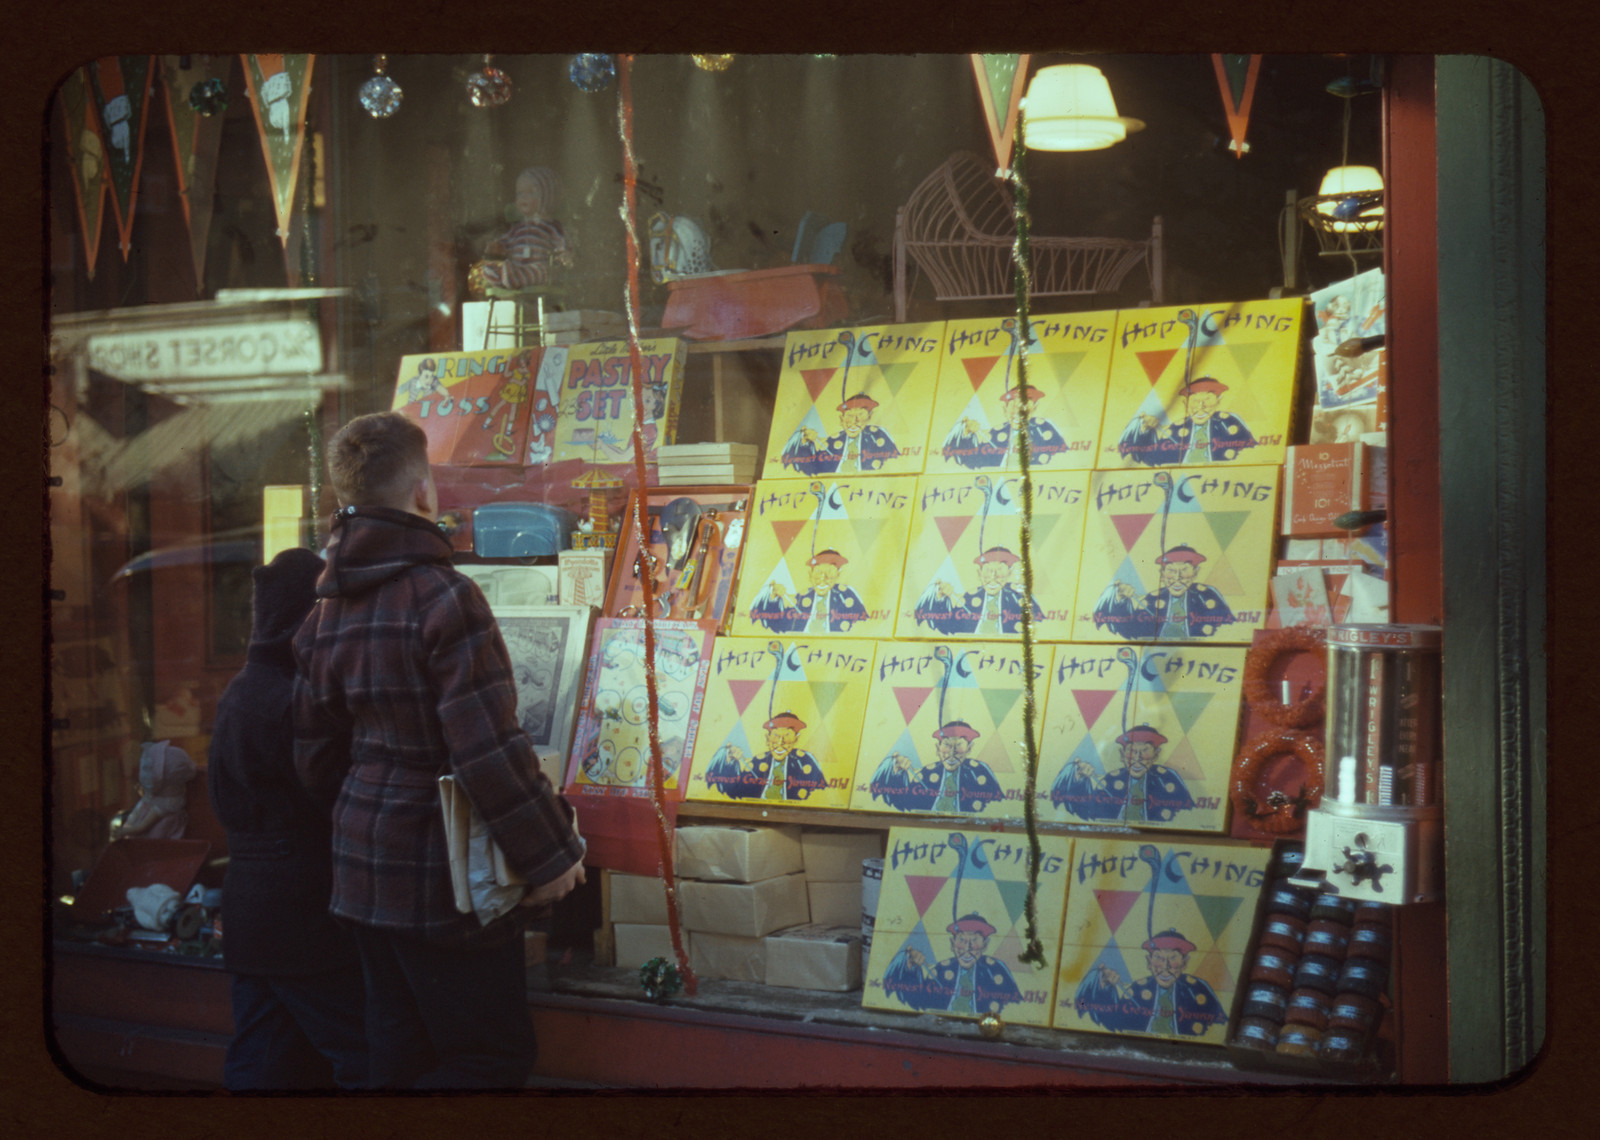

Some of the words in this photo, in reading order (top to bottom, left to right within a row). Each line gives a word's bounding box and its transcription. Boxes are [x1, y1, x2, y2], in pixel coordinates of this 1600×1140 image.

[949, 326, 1000, 354] HOP
[1121, 319, 1176, 348] HOP
[1201, 310, 1292, 336] CHING
[789, 340, 837, 367] HOP
[859, 332, 938, 357] CHING
[437, 355, 504, 378] RING
[568, 353, 672, 389] PASTRY
[418, 397, 490, 418] TOSS
[575, 389, 626, 421] SET
[759, 488, 808, 516] HOP
[829, 484, 908, 510] CHING
[921, 482, 972, 511] HOP
[996, 478, 1082, 505] CING
[1096, 479, 1151, 510] HOP
[1177, 474, 1271, 503] CHING
[717, 645, 765, 674] HOP
[787, 644, 868, 672] CHING
[879, 650, 932, 680] HOP
[1058, 652, 1115, 684] HOP
[1141, 652, 1236, 683] CHING
[892, 836, 946, 869] HOP
[1078, 849, 1137, 883] HOP
